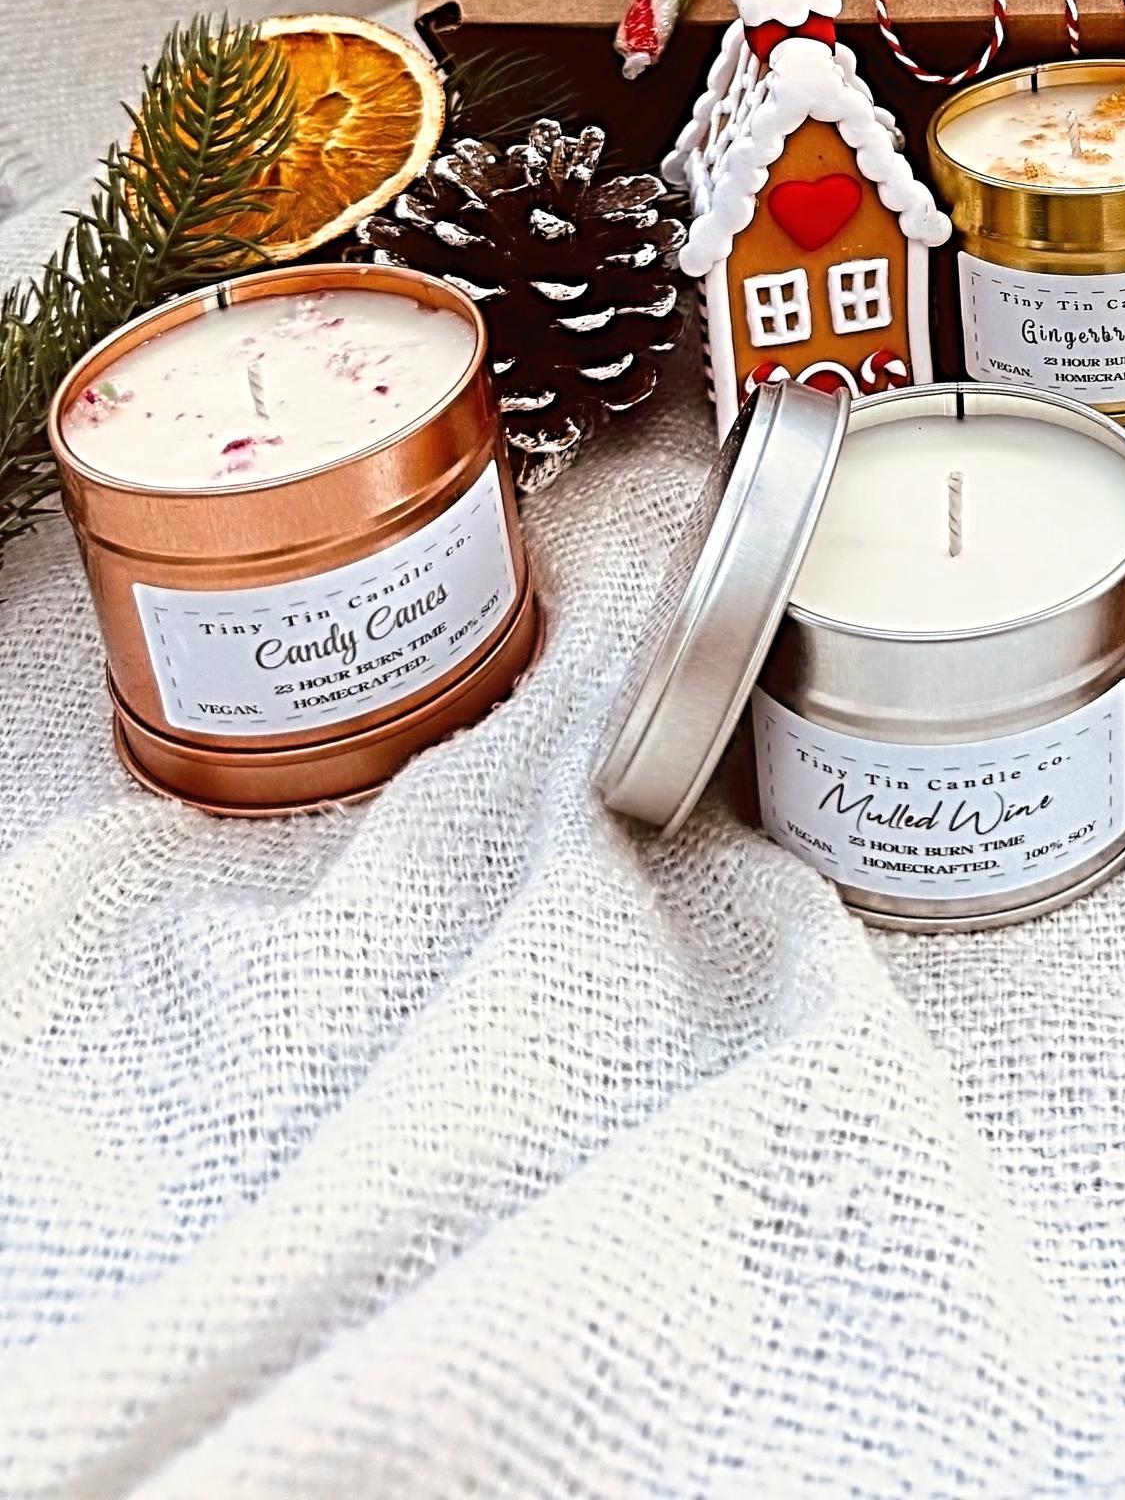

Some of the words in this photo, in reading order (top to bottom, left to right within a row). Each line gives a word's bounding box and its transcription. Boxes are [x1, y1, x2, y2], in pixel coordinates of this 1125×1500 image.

[1000, 291, 1044, 310] Tiny
[1057, 300, 1093, 311] Tin
[988, 358, 1033, 378] VEGAN.
[1043, 356, 1058, 365] 23
[1061, 357, 1101, 368] HOUR
[199, 623, 263, 637] Tiny
[282, 609, 331, 628] Tin
[347, 559, 435, 609] Candle
[444, 534, 472, 558] co.
[197, 702, 263, 715] VEGAN.
[292, 653, 430, 710] HOMECRAFTED.
[447, 617, 479, 647] 100%
[480, 589, 501, 618] SOY
[255, 623, 358, 670] Candy
[366, 581, 448, 642] Canes
[274, 682, 295, 695] 23
[299, 668, 352, 691] HOUR
[356, 647, 404, 676] BURN
[407, 620, 449, 653] TIME
[796, 748, 849, 779] Tiny
[865, 772, 910, 790] Tin
[927, 769, 1022, 791] Candle
[1038, 754, 1072, 772] co.
[818, 782, 943, 833] Mulled
[949, 790, 1056, 836] Wine
[786, 820, 837, 855] VEGAN.
[862, 856, 1000, 875] HOMECRAFTED.
[1023, 840, 1063, 861] 100%
[1067, 820, 1098, 843] SOY
[848, 834, 866, 848] 23
[871, 840, 919, 856] HOUR
[924, 843, 975, 857] BURN
[979, 833, 1026, 853] TIME
